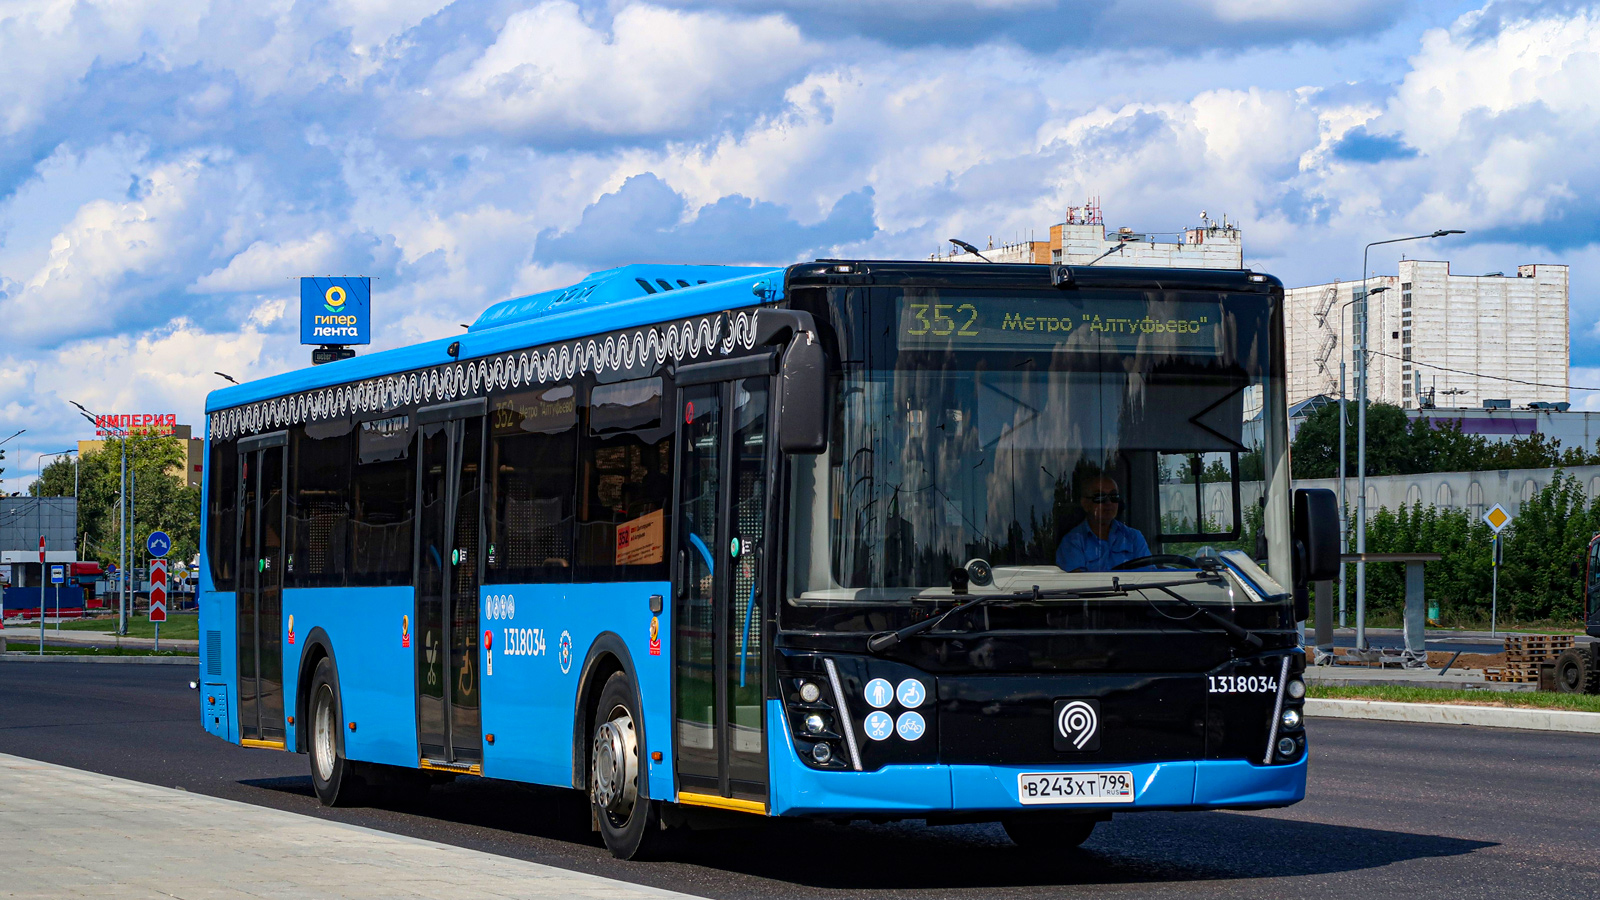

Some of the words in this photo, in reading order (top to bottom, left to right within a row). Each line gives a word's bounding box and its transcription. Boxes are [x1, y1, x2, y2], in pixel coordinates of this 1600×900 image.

[314, 315, 358, 327] гипер
[907, 303, 979, 336] 352
[1001, 312, 1073, 333] Метро
[1082, 313, 1209, 334] "Алтуфьево"
[313, 326, 359, 337] лента
[95, 413, 177, 428] ИМПЕРИЯ
[495, 400, 514, 429] 352
[518, 404, 538, 420] Метро
[504, 627, 547, 657] 1318034
[1208, 675, 1278, 693] 1318034
[1027, 776, 1096, 797] В243ХТ
[1100, 774, 1126, 790] 799
